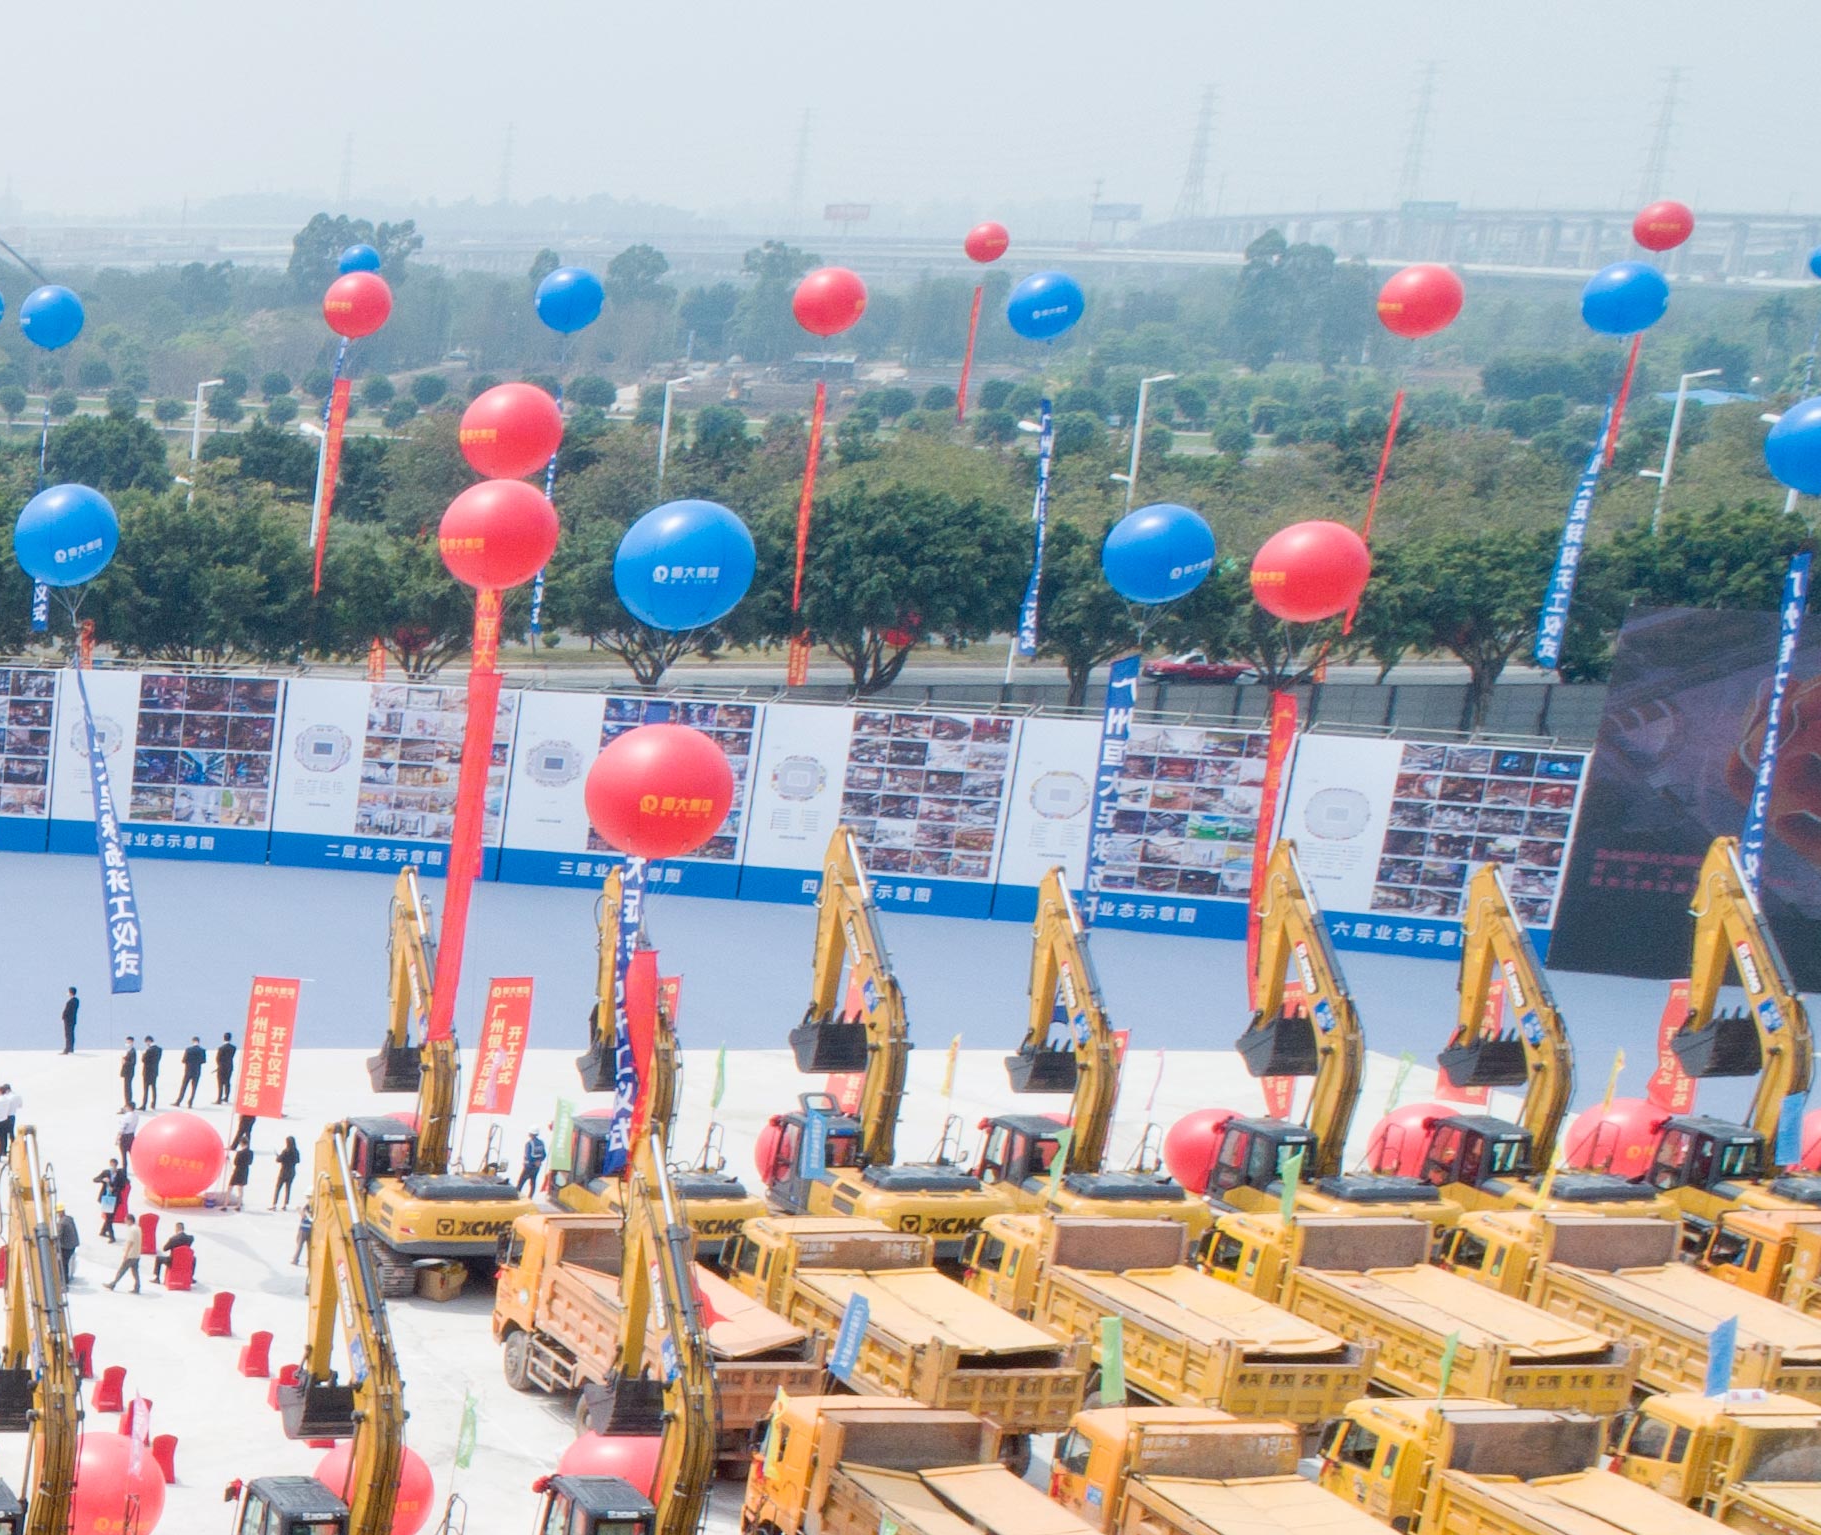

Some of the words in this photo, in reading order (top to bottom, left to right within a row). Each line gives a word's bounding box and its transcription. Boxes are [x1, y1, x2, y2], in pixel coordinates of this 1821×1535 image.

[671, 566, 719, 578] 恒大集团
[662, 798, 713, 811] 恒大集团
[325, 843, 443, 867] 二层业态示意图
[558, 860, 682, 883] 三层业意图
[802, 878, 932, 904] 四示意图
[1332, 921, 1463, 947] 六层业态示意
[242, 1001, 266, 1108] 广州恒大足球场
[263, 1025, 288, 1089] 开工仪式
